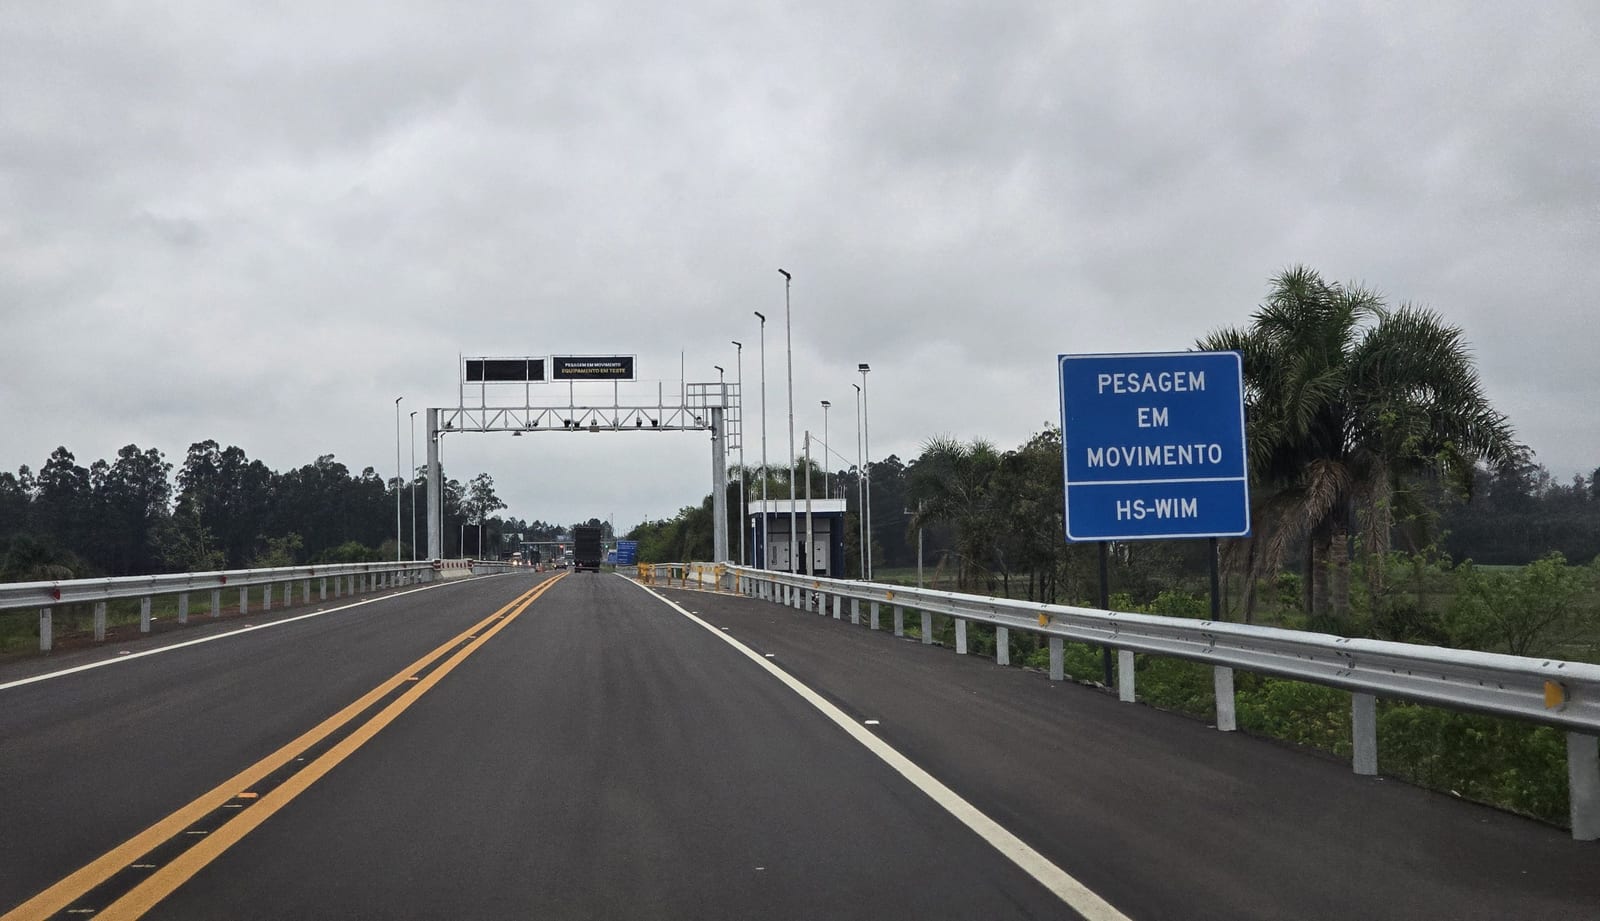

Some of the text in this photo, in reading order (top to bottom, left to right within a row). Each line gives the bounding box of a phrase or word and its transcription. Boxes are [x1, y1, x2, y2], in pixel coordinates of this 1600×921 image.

[1098, 371, 1206, 394] PESAGEM
[1138, 407, 1169, 428] EM
[1087, 443, 1222, 468] MOVIMENTO
[1116, 497, 1198, 521] HS-WIM
